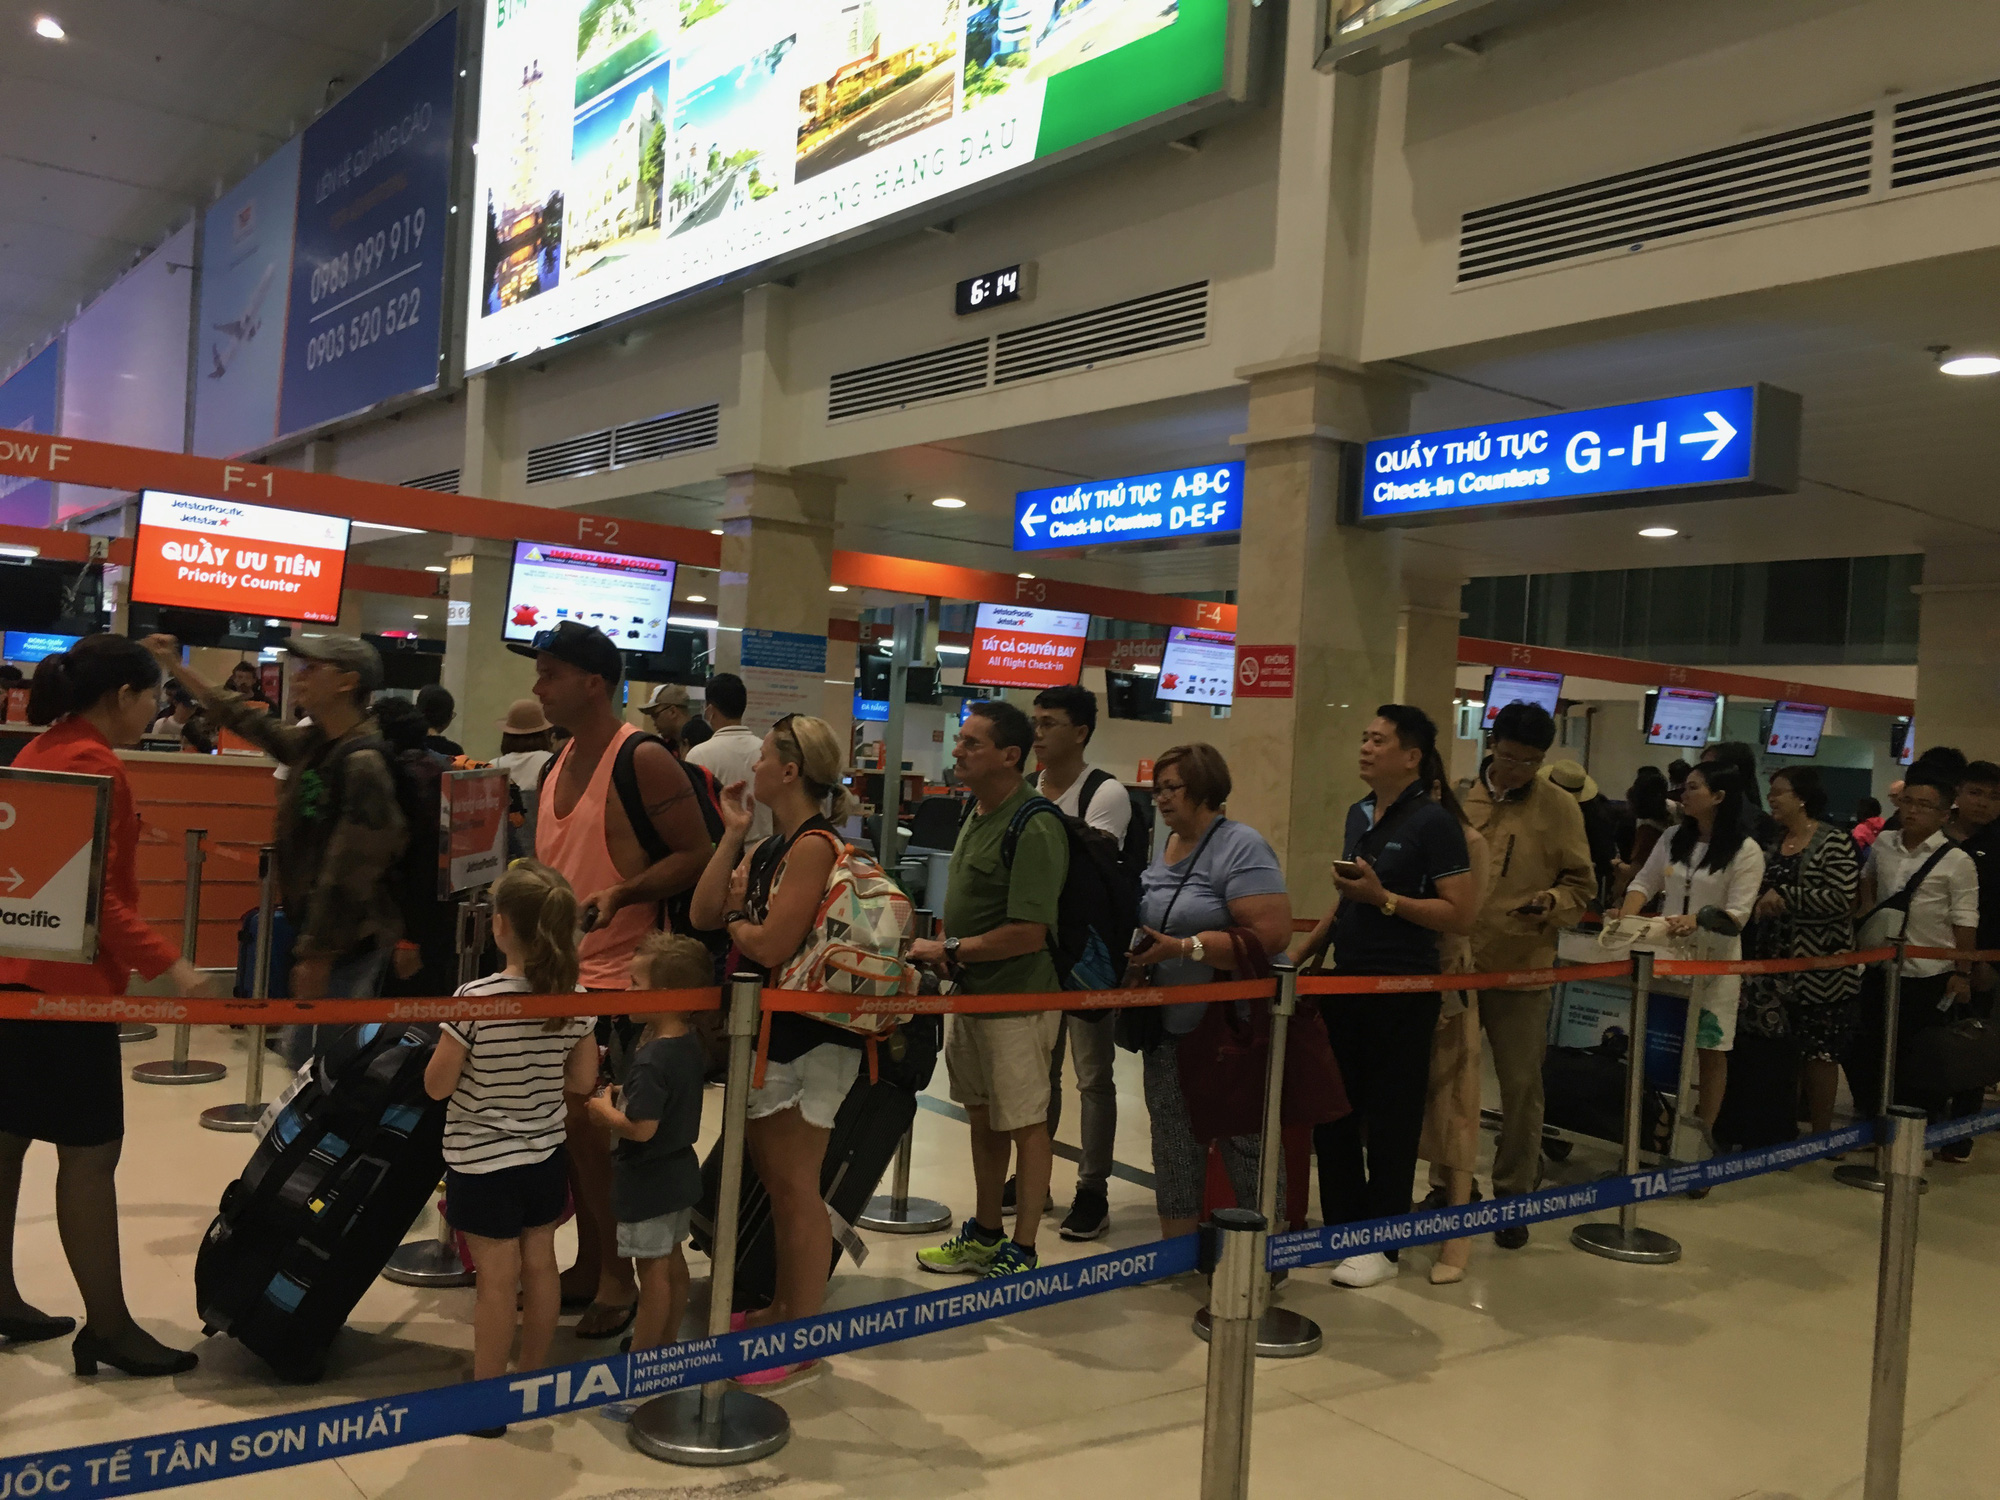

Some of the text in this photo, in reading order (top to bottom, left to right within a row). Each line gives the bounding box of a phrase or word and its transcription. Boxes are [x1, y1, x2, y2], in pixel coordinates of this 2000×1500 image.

[310, 251, 349, 304] 0983
[354, 230, 386, 281] 999
[389, 207, 426, 262] 919
[970, 271, 1017, 305] 6:14
[306, 287, 421, 372] 0903 520 522
[49, 443, 72, 471] F
[1443, 431, 1491, 465] THỦ
[1497, 429, 1549, 460] TỤC
[223, 465, 274, 497] F-1
[1171, 469, 1230, 499] A-B-C
[1458, 467, 1550, 493] Counters
[171, 499, 245, 517] JetstarPacific
[1128, 483, 1162, 508] TỤC
[180, 514, 218, 526] Jetstar
[1104, 512, 1162, 533] Counters
[1169, 501, 1227, 530] D-E-F
[577, 517, 620, 545] F-2
[161, 537, 230, 566] QUẦY
[273, 553, 321, 578] TIÊN
[549, 549, 618, 565] IMPORTANT
[619, 558, 661, 571] NOTICE
[178, 566, 301, 593] Priority Counter
[1015, 580, 1046, 602] F-3
[1196, 603, 1222, 624] F-4
[988, 656, 1064, 671] All flight Check-in
[1057, 646, 1076, 657] BAY
[0, 910, 61, 929] acific
[31, 997, 187, 1019] JetstarPacific
[387, 1001, 522, 1019] JetstarPacific
[856, 998, 954, 1012] JetstarPacific
[1631, 1173, 1668, 1198] TIA
[1373, 1220, 1412, 1243] HÀNG
[1414, 1211, 1460, 1237] KHÔNG
[1463, 1204, 1498, 1229] QUỐC
[1519, 1197, 1541, 1219] TÂN
[739, 1251, 1158, 1363] TAN SON NHAT INTERNATIONAL AIRPORT
[635, 1338, 718, 1364] TAN SON NHAT
[634, 1352, 723, 1379] INTERNATIONAL
[509, 1363, 621, 1414] TIA
[633, 1373, 685, 1394] AIRPORT
[84, 1445, 132, 1486] TẾ
[144, 1438, 217, 1476] TÂN
[229, 1425, 306, 1463] SƠN
[317, 1402, 410, 1447] NHẤT
